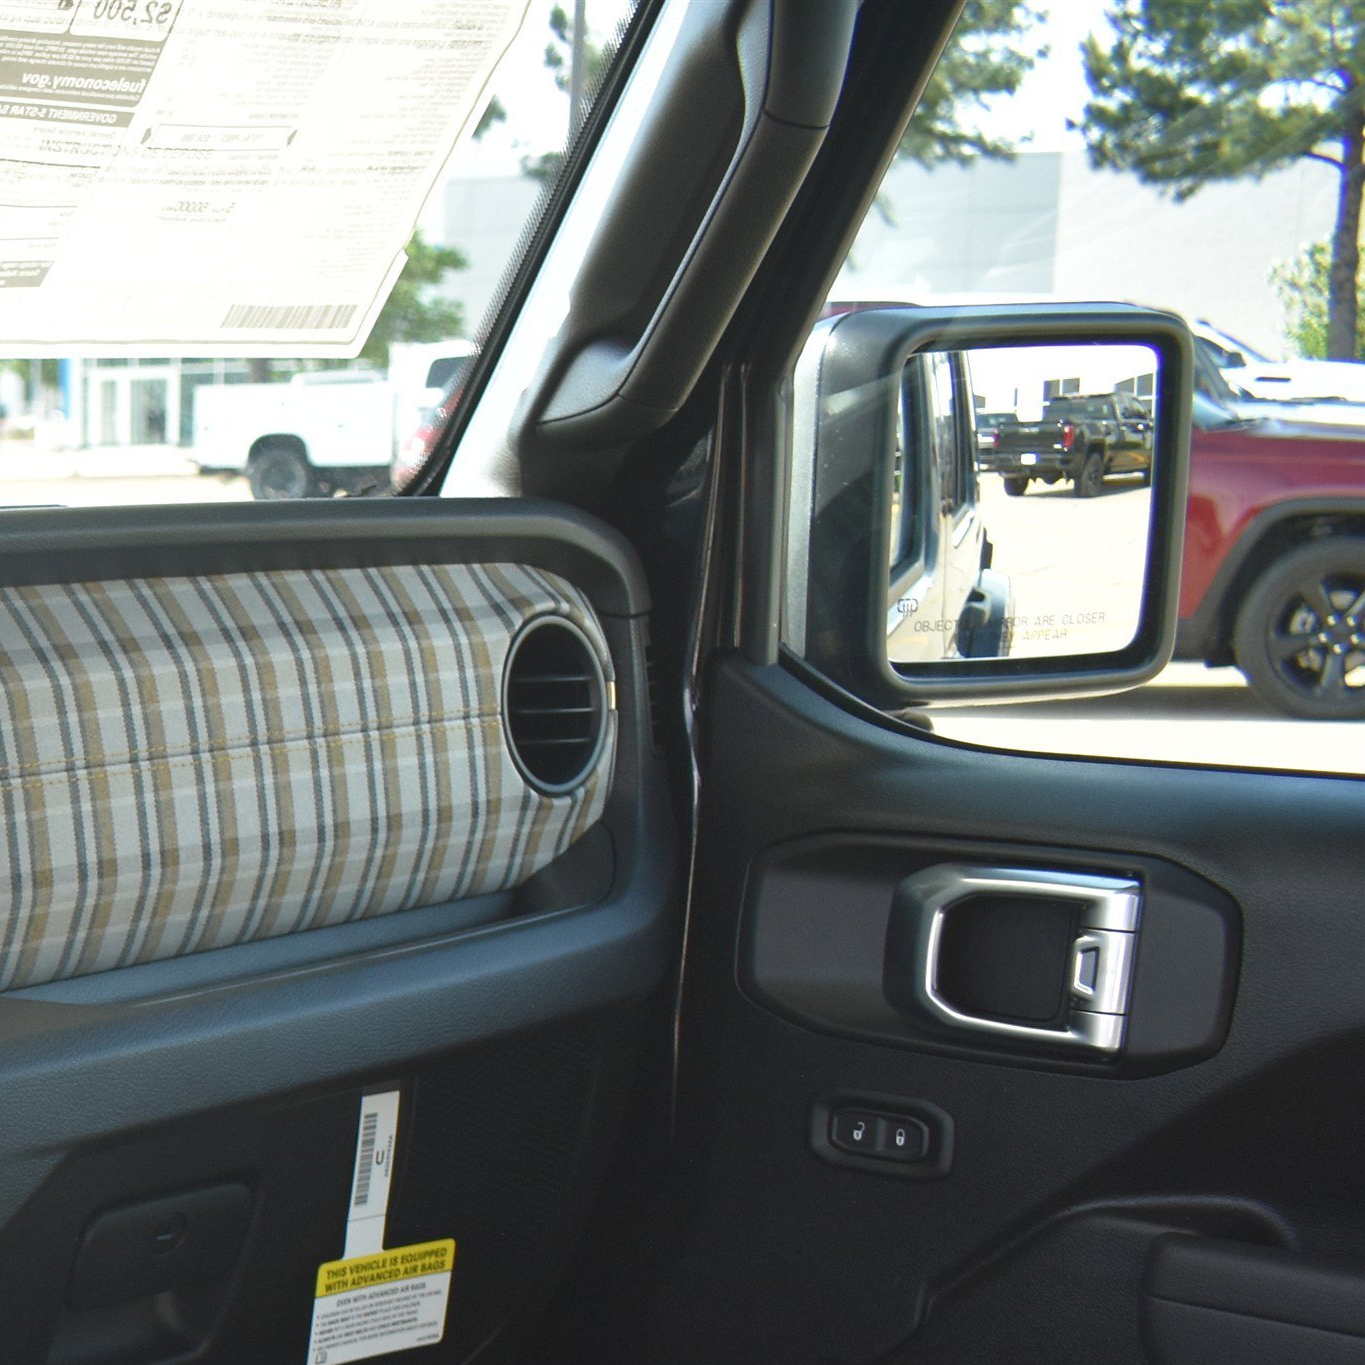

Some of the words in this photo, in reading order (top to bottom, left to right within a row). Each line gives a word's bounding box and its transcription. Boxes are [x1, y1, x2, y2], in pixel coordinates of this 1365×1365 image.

[914, 619, 958, 633] OBJECT
[1035, 614, 1056, 626] ARE
[1061, 612, 1107, 626] CLOSER
[325, 1280, 349, 1293] WITH
[351, 1268, 401, 1287] ADVANCED
[402, 1265, 418, 1276] AIR
[420, 1260, 446, 1272] BAGS
[326, 1268, 347, 1279] THIS
[350, 1259, 387, 1275] VEHICLE
[389, 1255, 398, 1265] IS
[400, 1248, 447, 1264] EQUIPPED
